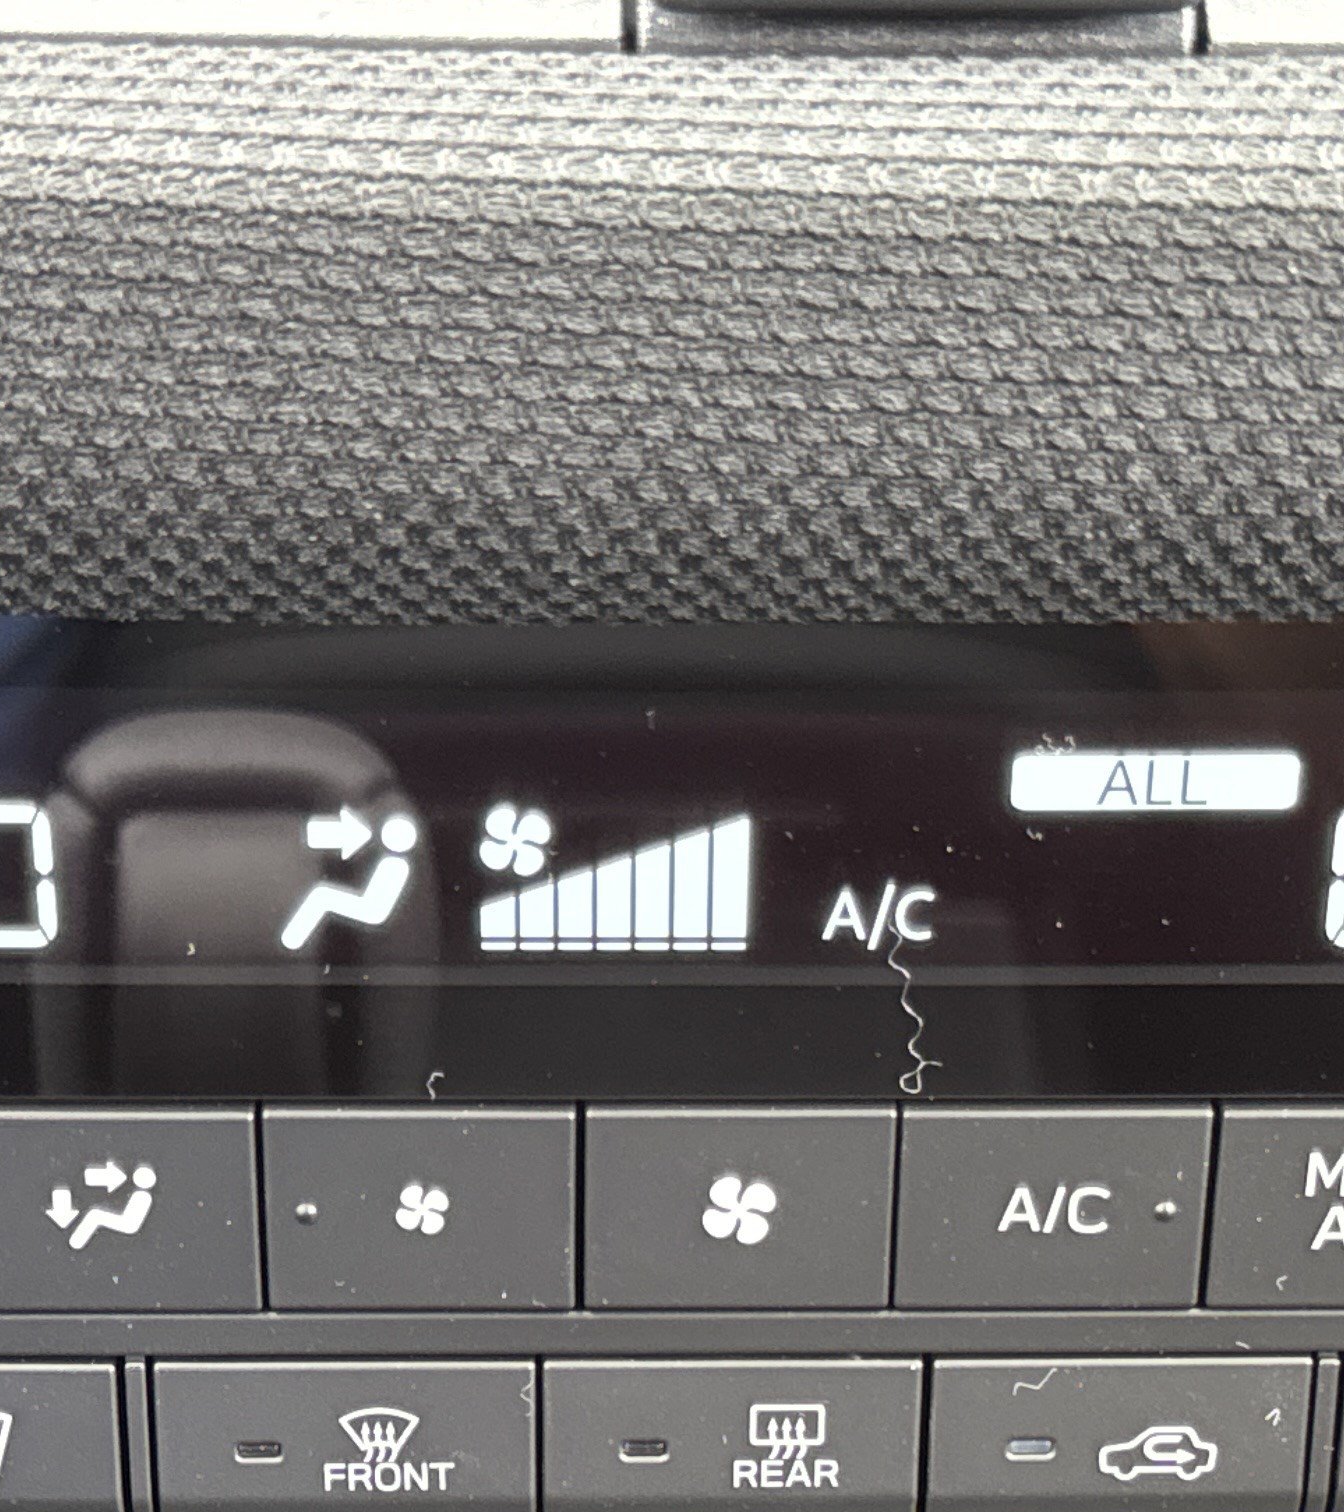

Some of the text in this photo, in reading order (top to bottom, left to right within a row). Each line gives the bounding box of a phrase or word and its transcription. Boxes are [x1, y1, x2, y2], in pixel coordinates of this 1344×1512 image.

[1096, 759, 1208, 806] ALL
[822, 880, 936, 951] A/C
[996, 1186, 1112, 1236] A/C
[322, 1462, 454, 1492] FRONT
[732, 1460, 840, 1490] REAR
